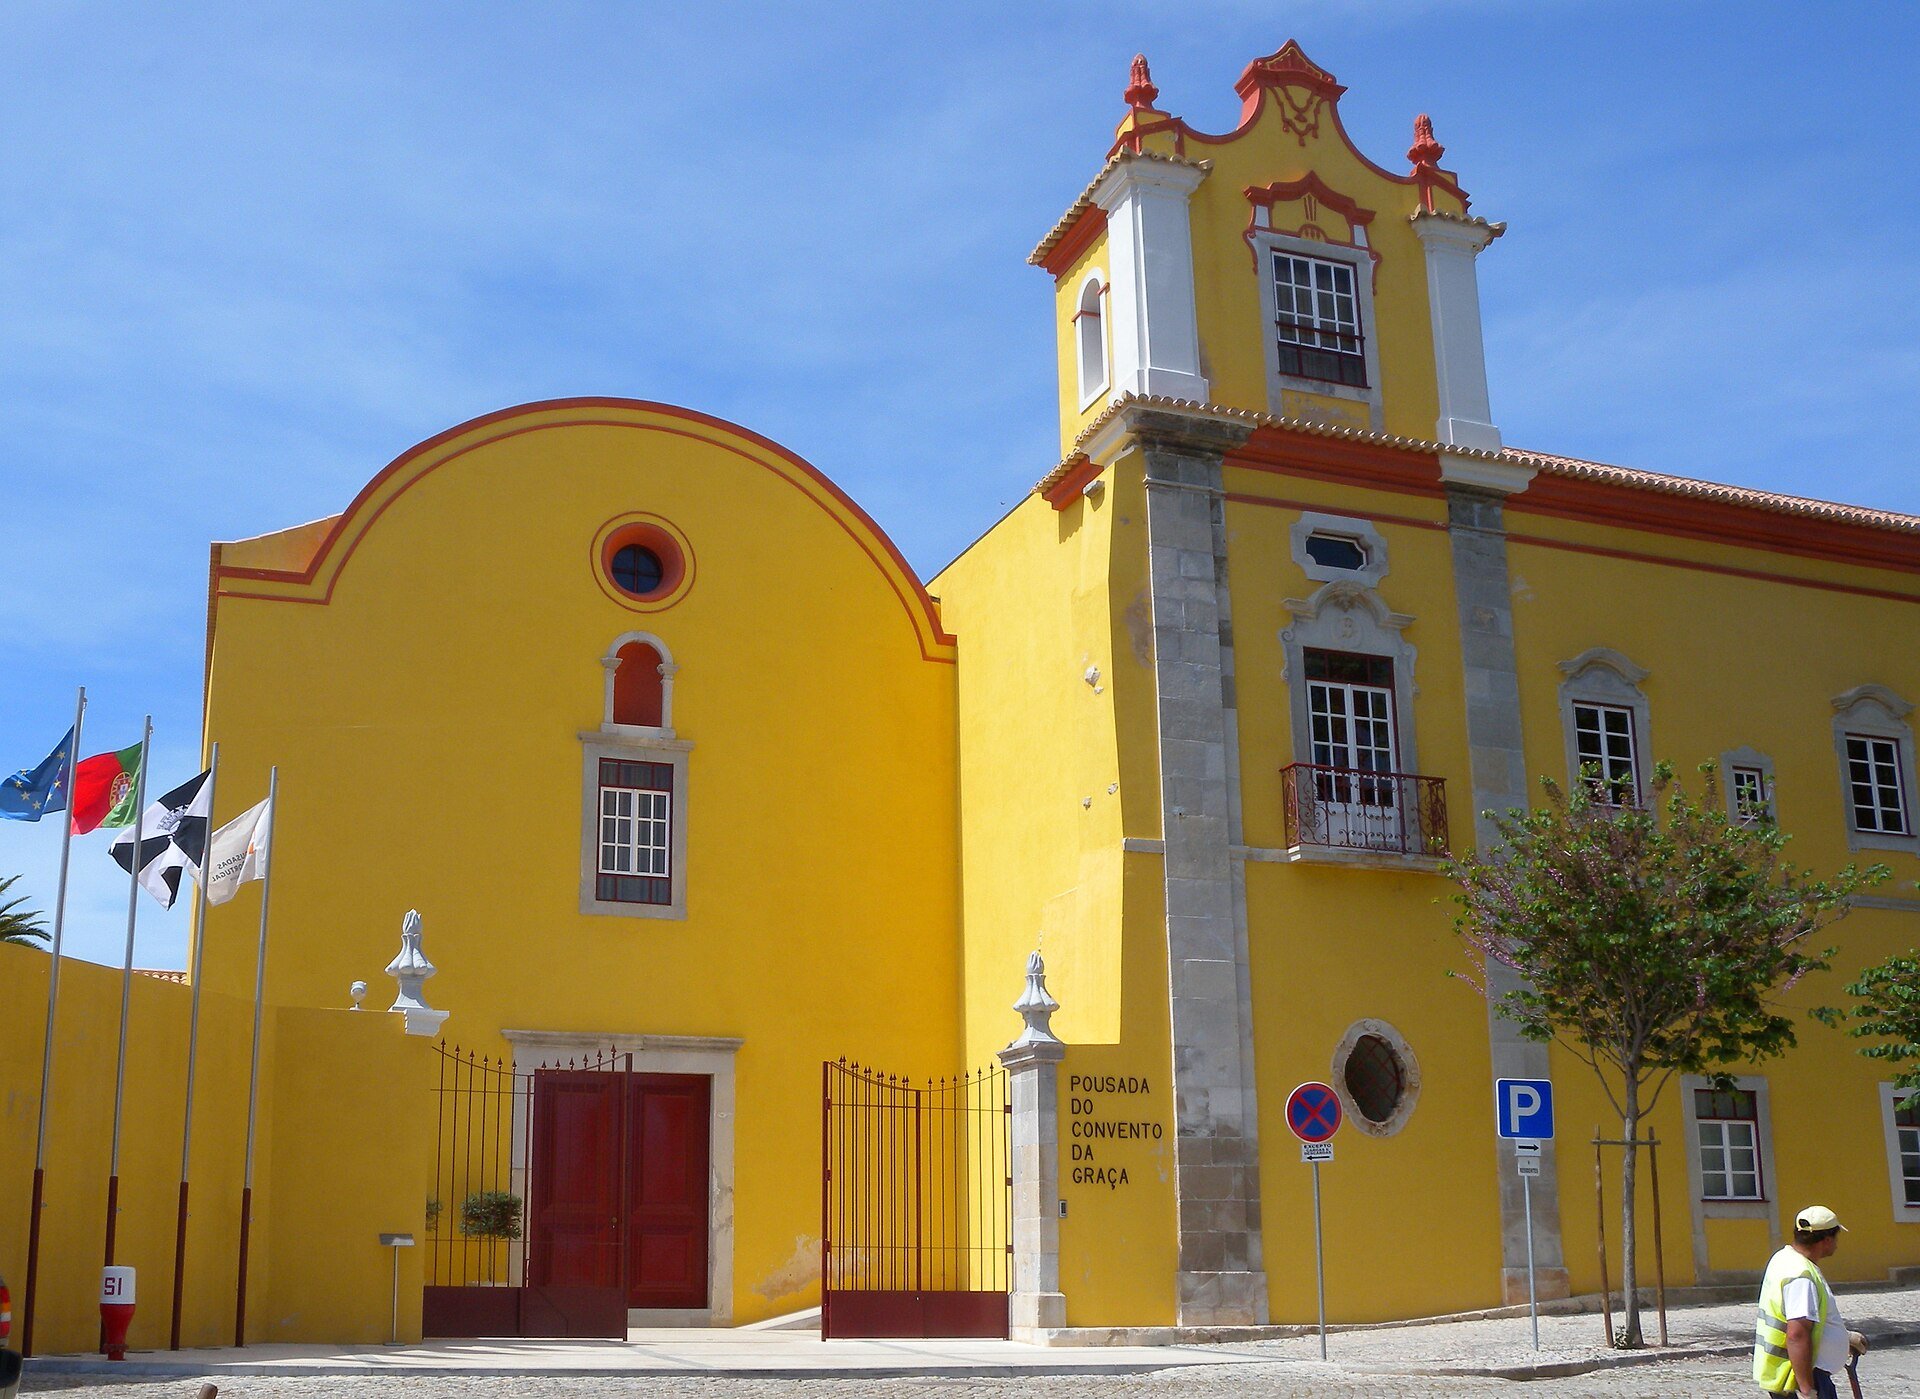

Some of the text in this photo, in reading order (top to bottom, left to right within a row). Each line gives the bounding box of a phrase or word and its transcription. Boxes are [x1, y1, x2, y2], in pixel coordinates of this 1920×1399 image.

[1070, 1075, 1150, 1093] POUSADA
[1071, 1098, 1094, 1115] DO
[1509, 1085, 1541, 1133] P
[1071, 1121, 1163, 1139] CONVENTO
[1072, 1144, 1094, 1161] DA
[1072, 1167, 1129, 1190] GRAÇA
